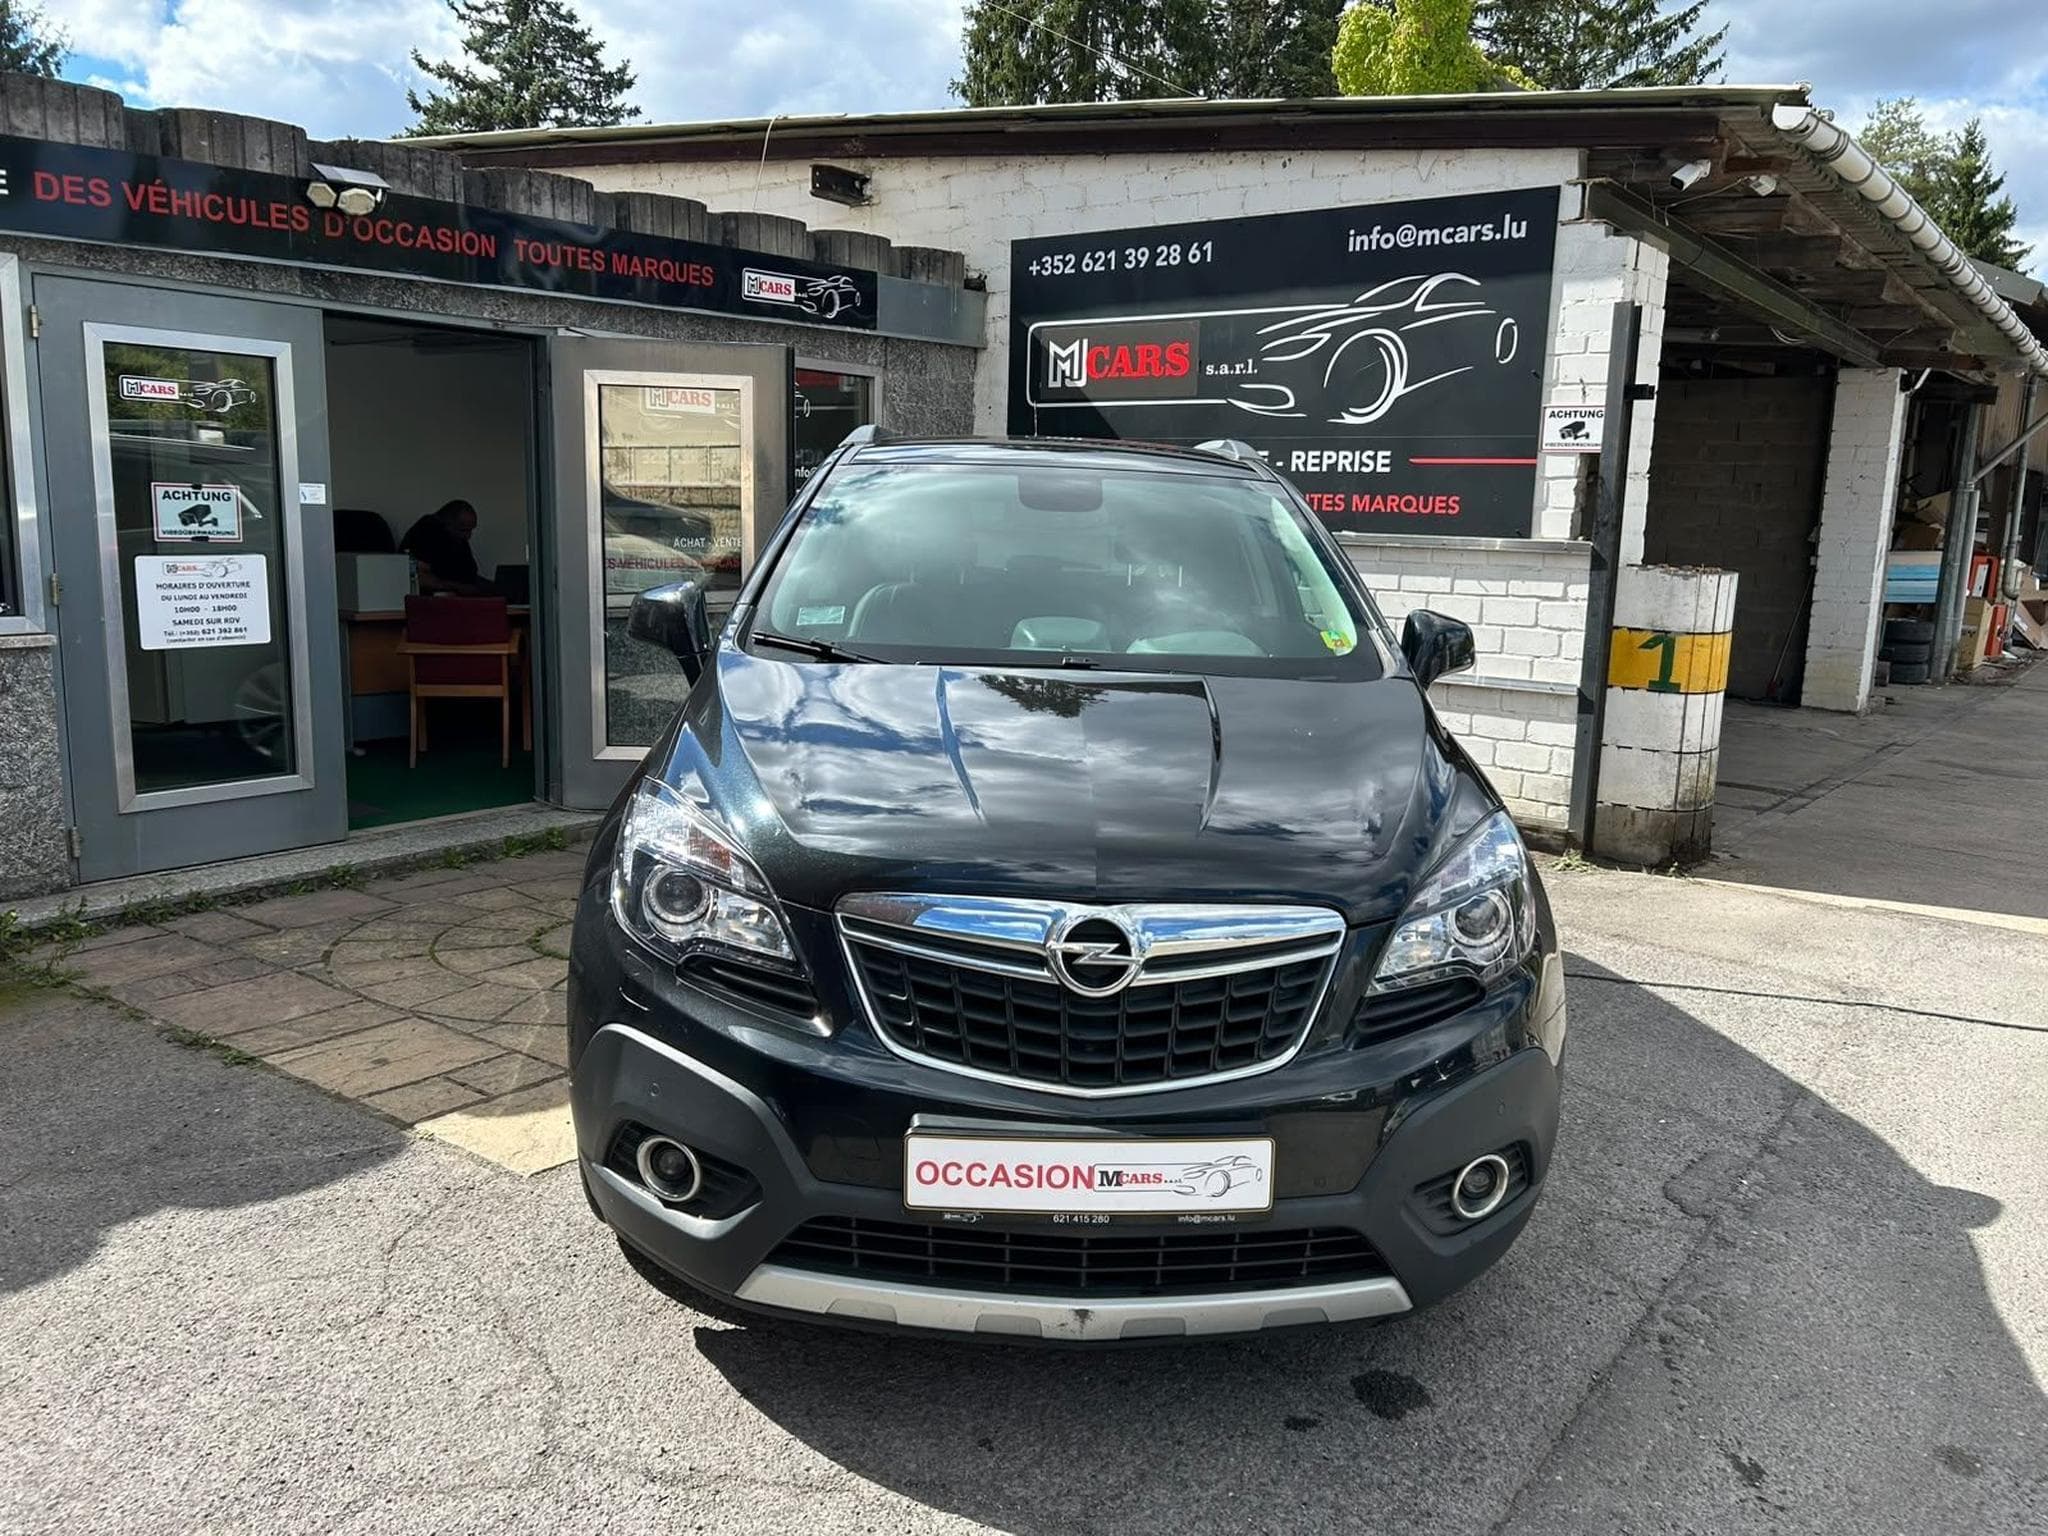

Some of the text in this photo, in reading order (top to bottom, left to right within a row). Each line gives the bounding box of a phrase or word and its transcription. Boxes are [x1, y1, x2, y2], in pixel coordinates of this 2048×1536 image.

[33, 170, 112, 208] DES
[121, 178, 310, 233] VÉHICULES
[323, 211, 496, 258] D'OCCASION
[514, 237, 606, 273] TOUTES
[611, 253, 715, 288] MARQUES
[1347, 213, 1528, 254] info@mcars.lu
[1028, 240, 1213, 278] +352 621 39 28 61
[1548, 410, 1605, 419] ACHTUNG
[1290, 450, 1392, 473] REPRISE
[162, 490, 232, 502] ACHTUNG
[1352, 494, 1460, 514] MARQUES
[672, 537, 706, 548] ACHAT
[713, 538, 742, 548] VENTE
[156, 582, 197, 590] HORAIRES
[174, 593, 198, 601] LUNDI
[211, 592, 248, 600] VENDREDI
[212, 604, 237, 612] 18H00
[172, 618, 204, 626] SAMEDI
[1638, 631, 1682, 693] 1
[914, 1160, 1096, 1190] OCCASION
[1052, 1214, 1070, 1223] 621
[1072, 1214, 1090, 1223] 415
